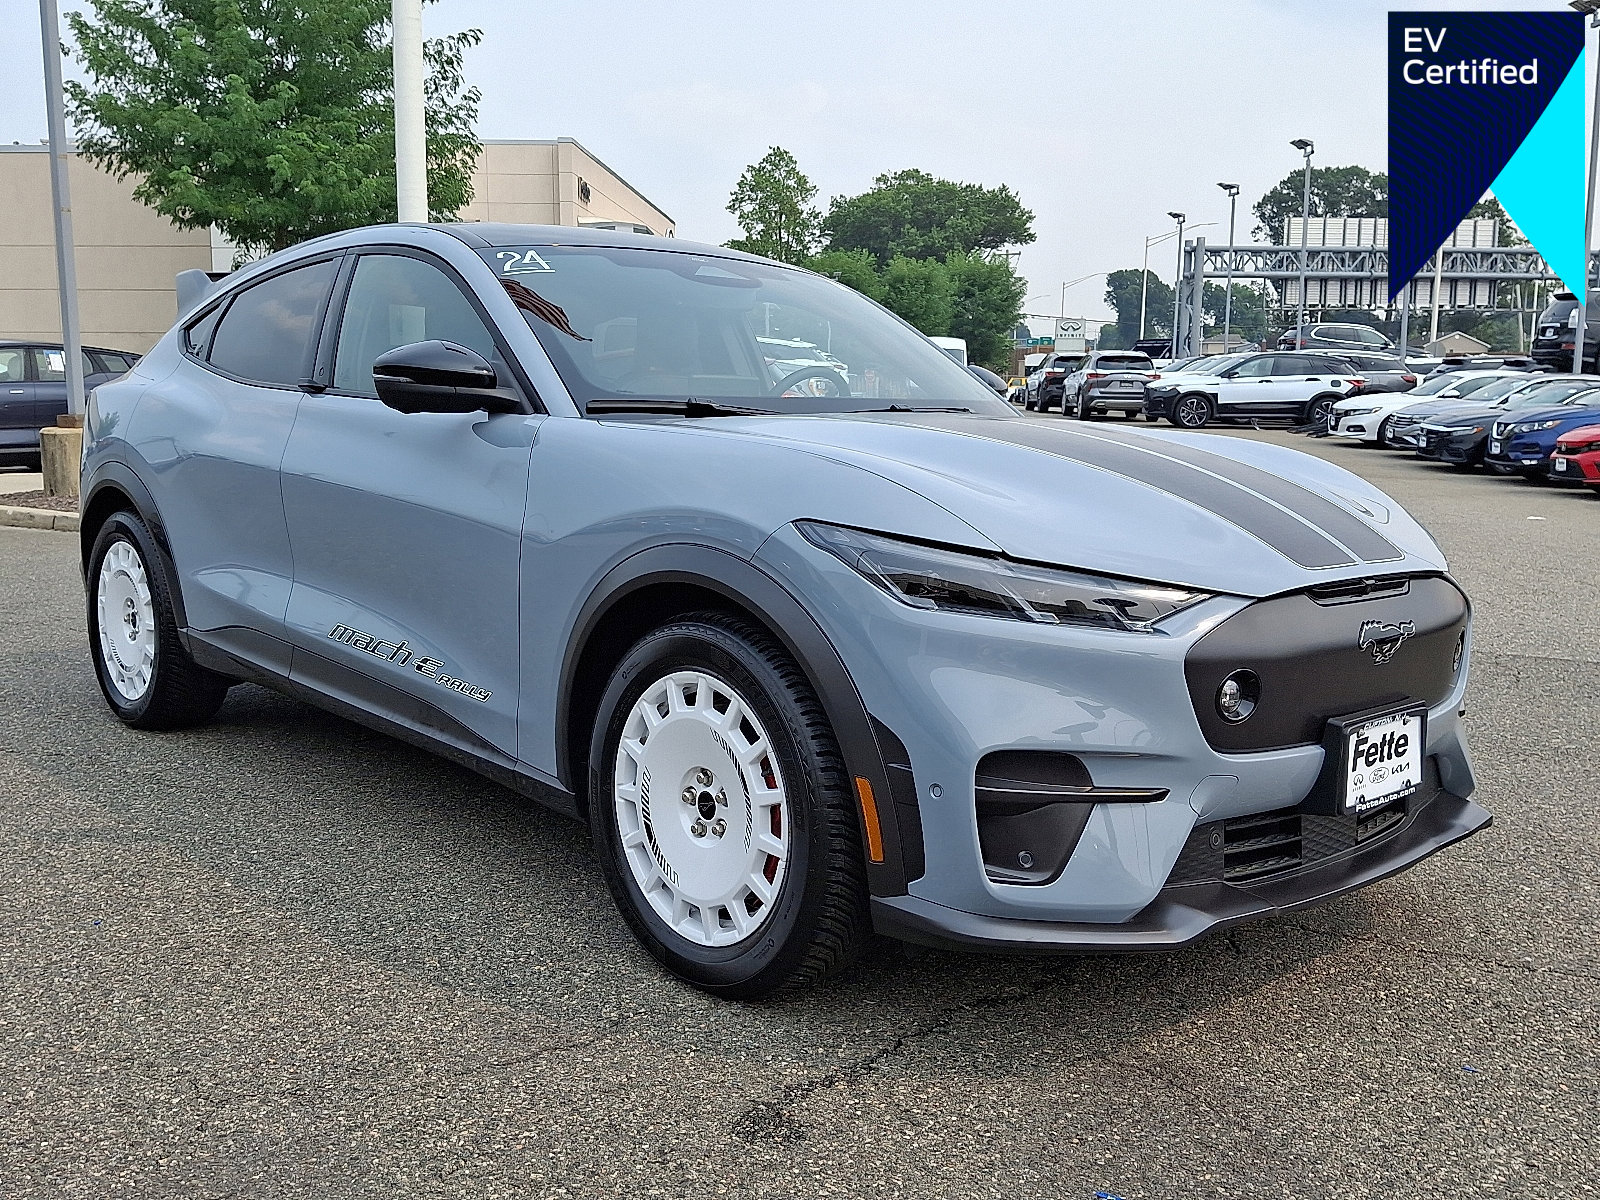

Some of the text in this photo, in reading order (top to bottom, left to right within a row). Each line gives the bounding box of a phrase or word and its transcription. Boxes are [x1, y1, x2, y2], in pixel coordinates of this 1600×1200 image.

[435, 673, 493, 703] RALLY
[1352, 730, 1409, 773] Fette
[1355, 786, 1416, 813] FetteAuto.com
